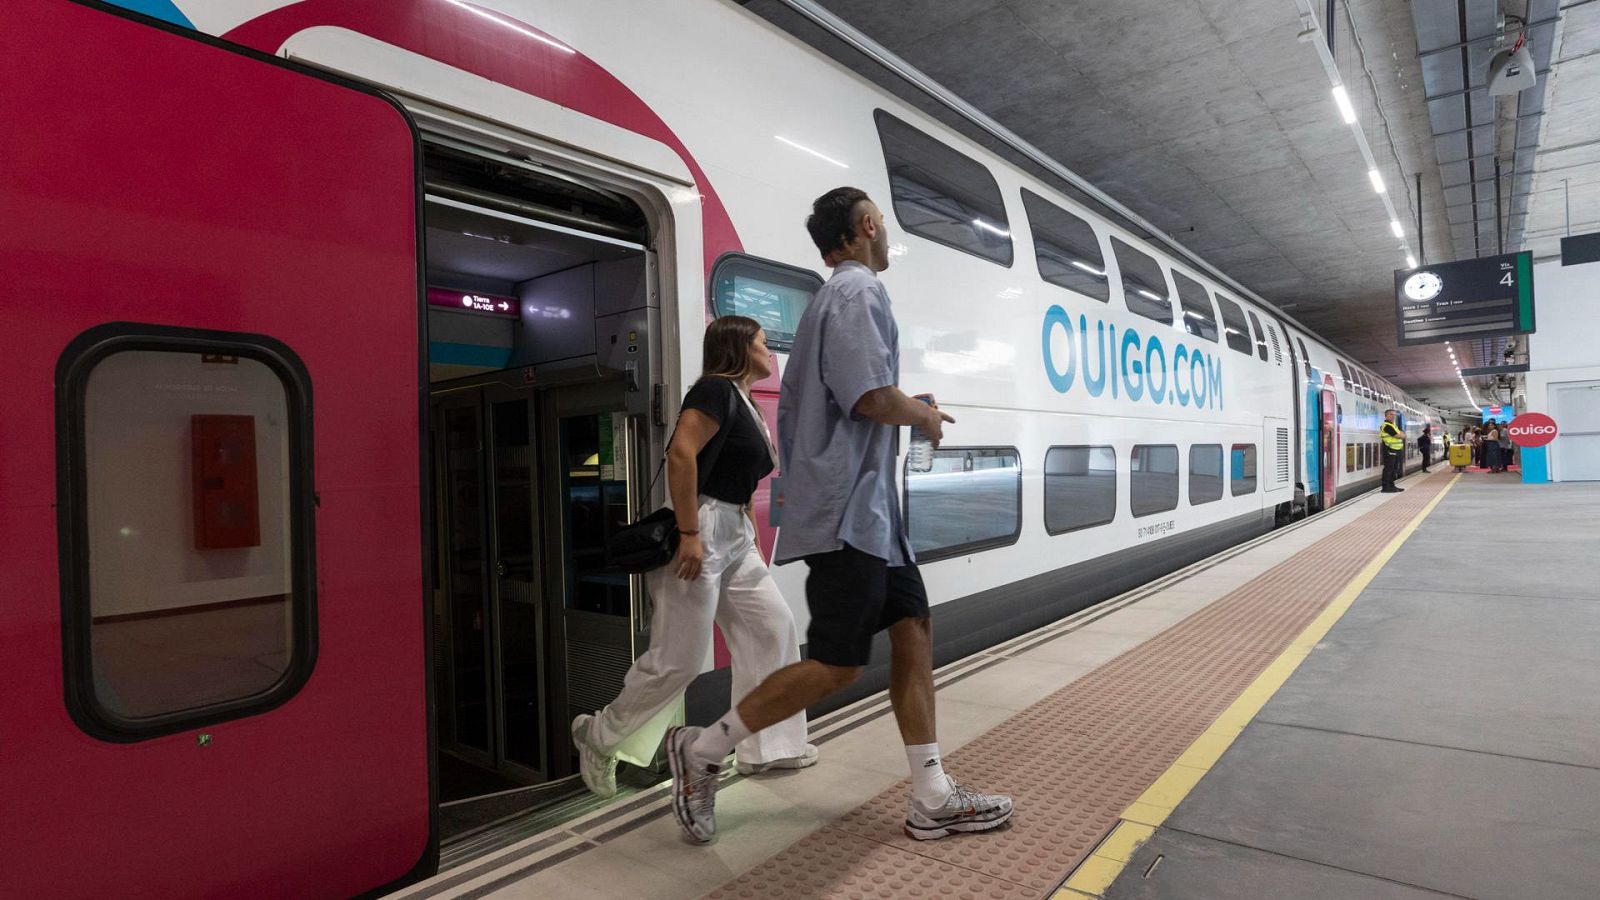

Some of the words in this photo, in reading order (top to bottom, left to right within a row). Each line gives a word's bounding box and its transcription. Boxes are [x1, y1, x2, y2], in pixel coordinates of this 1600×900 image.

[1499, 271, 1514, 287] 4
[473, 302, 494, 311] 1A-10E
[1042, 304, 1223, 411] OUIGO.COM
